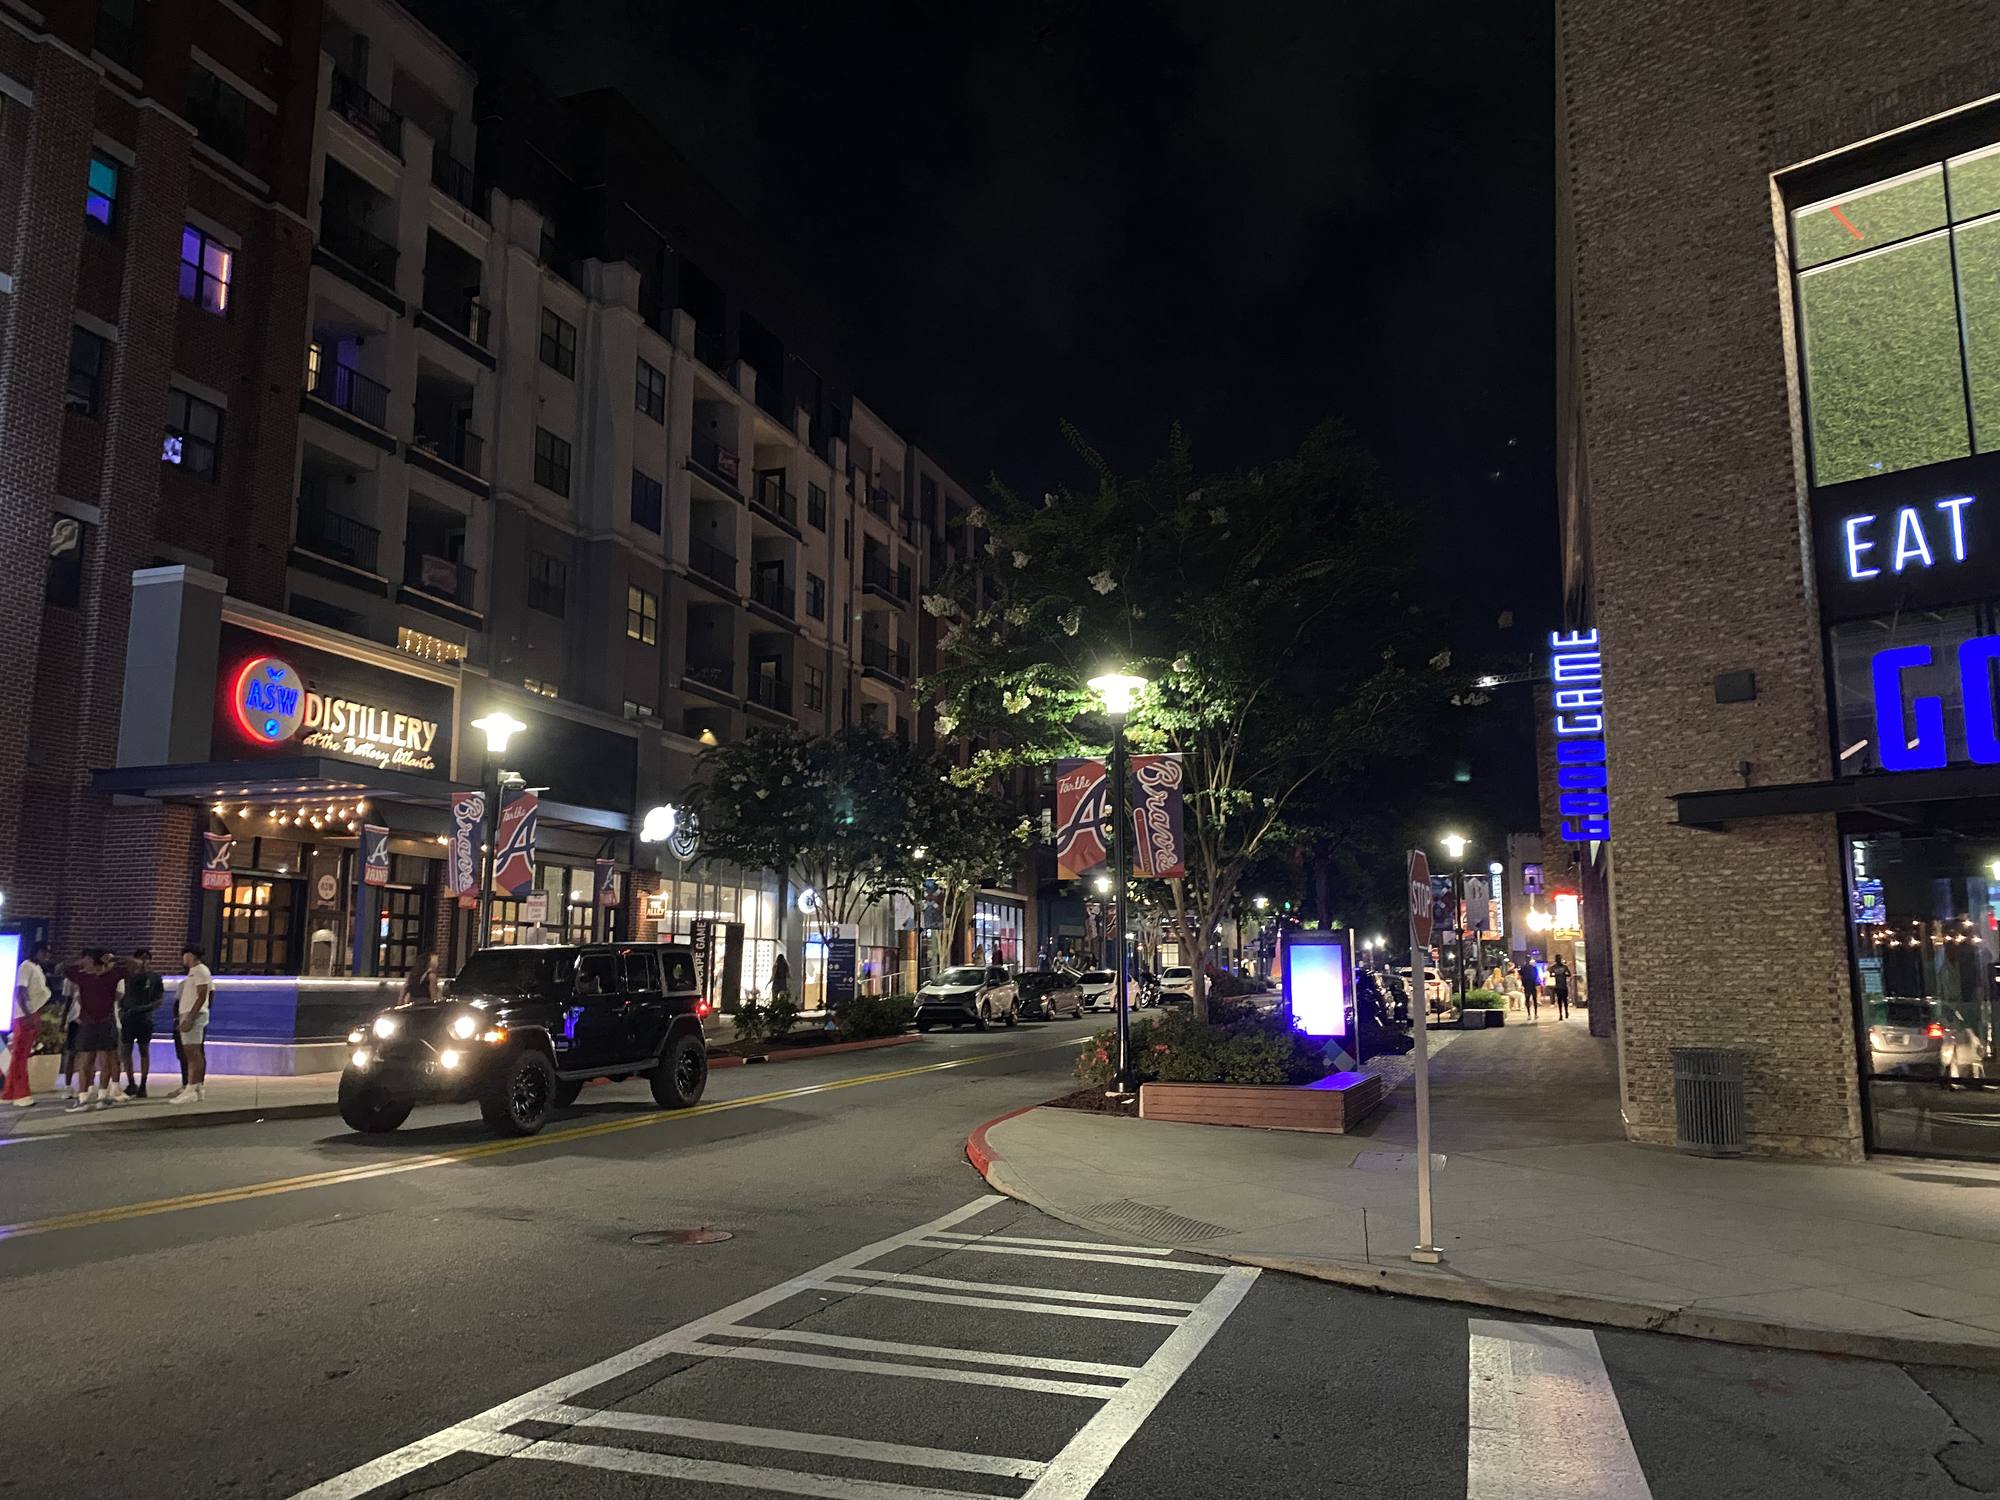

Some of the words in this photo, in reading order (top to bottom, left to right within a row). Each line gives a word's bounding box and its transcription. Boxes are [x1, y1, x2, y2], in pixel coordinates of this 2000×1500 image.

[1845, 496, 1975, 579] EAT
[246, 679, 299, 718] ASW
[1552, 627, 1604, 736] GAME
[304, 692, 438, 752] DISTILLERY
[318, 732, 341, 751] the
[343, 737, 391, 769] Battery
[392, 747, 435, 770] Atlanta
[1073, 775, 1092, 790] the
[1557, 739, 1611, 842] GOOD
[1057, 774, 1107, 858] A
[207, 842, 230, 870] A
[368, 836, 388, 865] A
[496, 804, 538, 877] A
[646, 908, 665, 916] ALLEY
[1411, 880, 1431, 919] STOP
[695, 921, 706, 950] GAME
